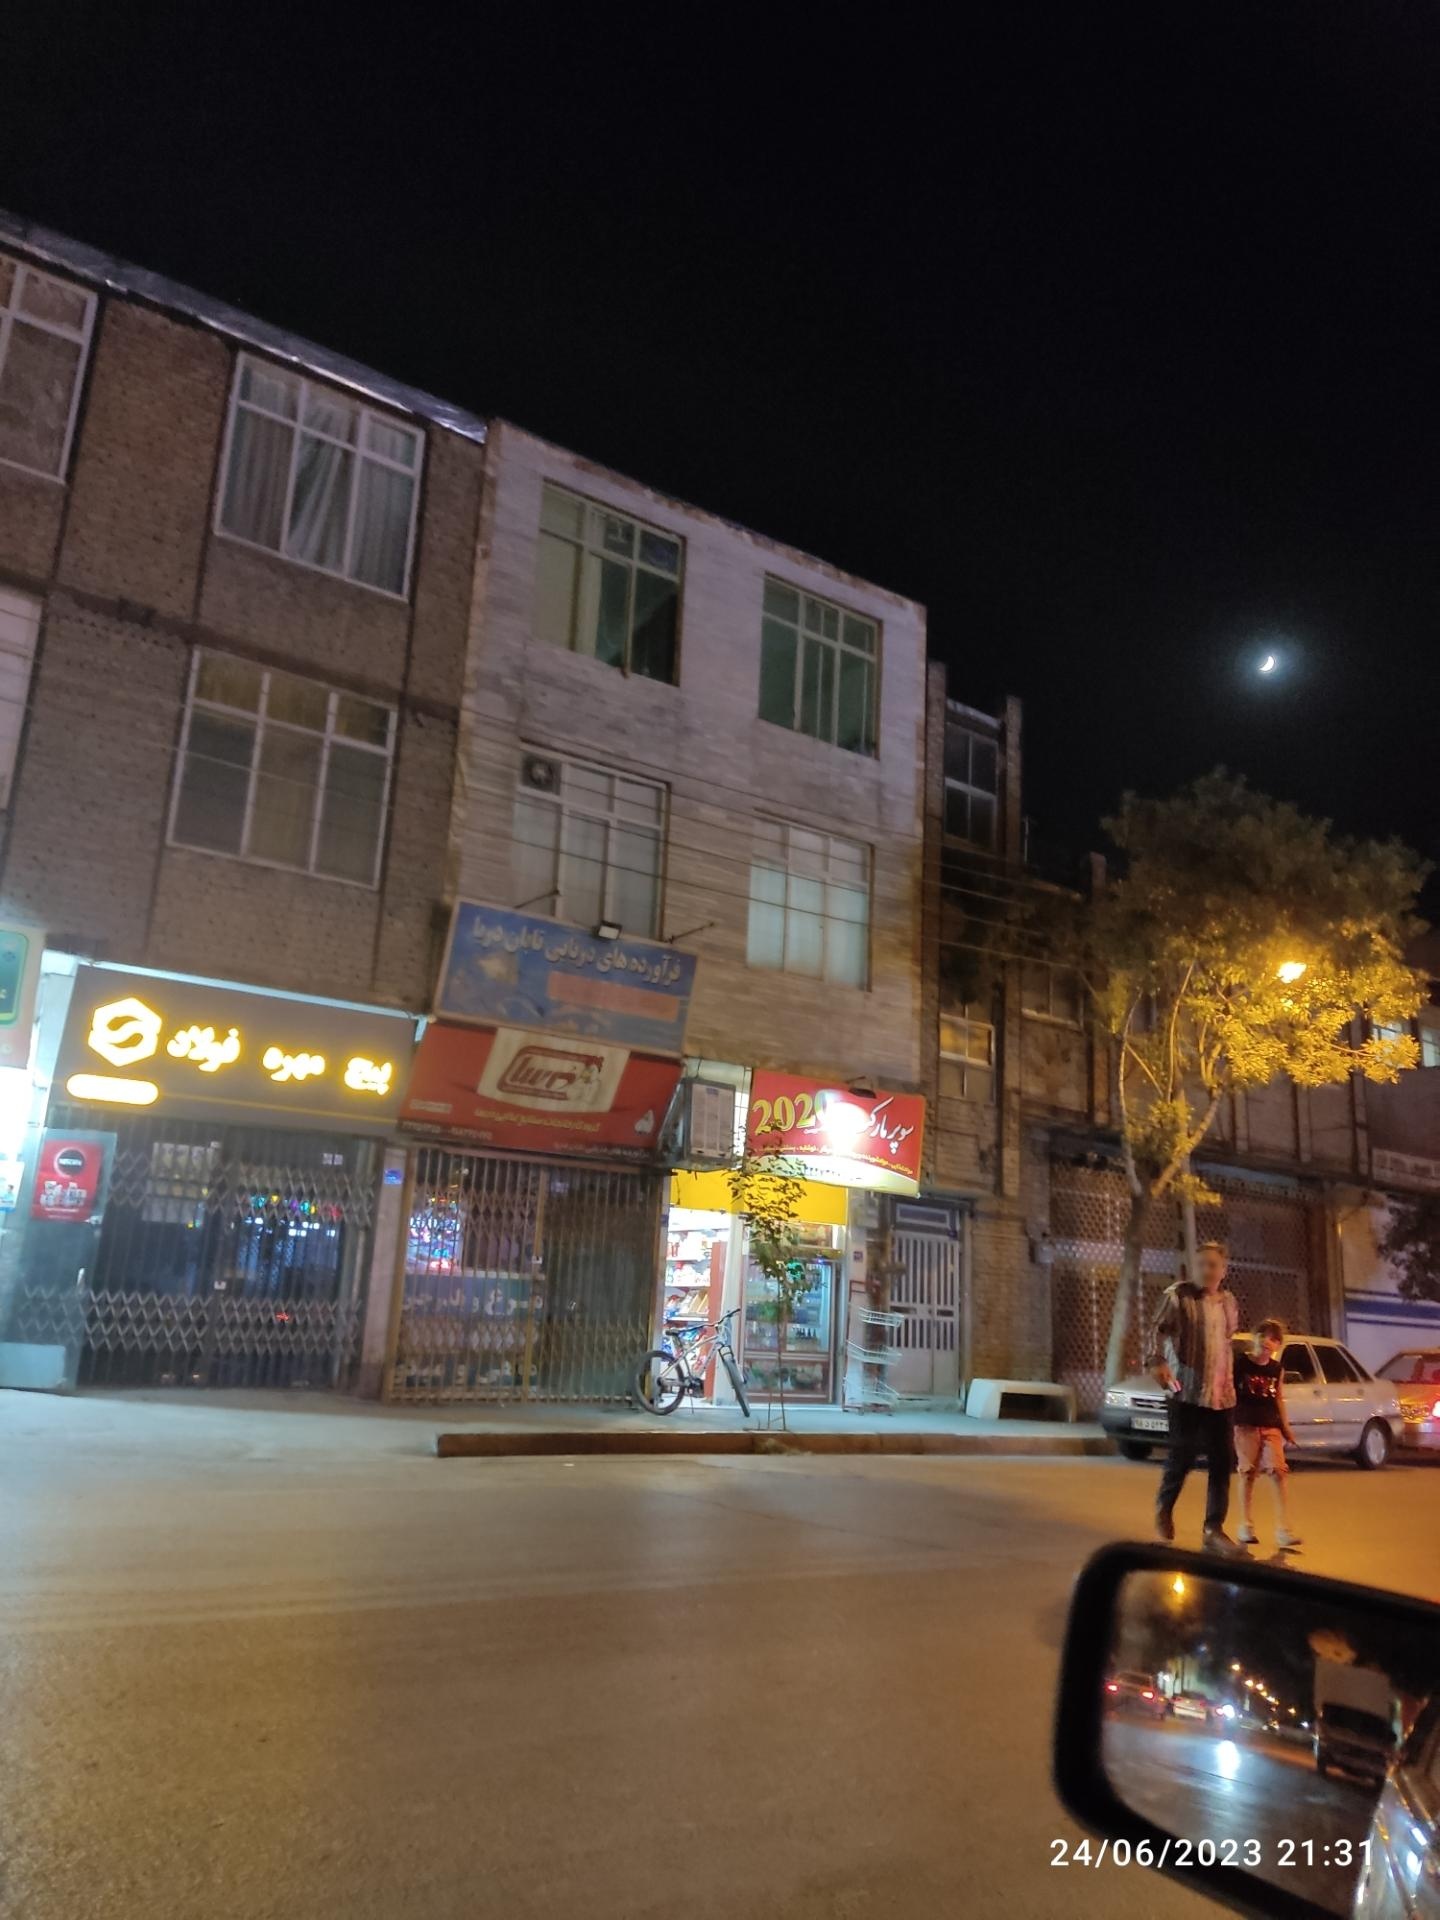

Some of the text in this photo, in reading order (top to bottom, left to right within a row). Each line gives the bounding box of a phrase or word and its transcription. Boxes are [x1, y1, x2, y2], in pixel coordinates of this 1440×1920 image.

[596, 945, 627, 973] های
[629, 953, 682, 987] فرآورده
[166, 1024, 241, 1073] فولاد
[262, 1046, 326, 1082] مهره
